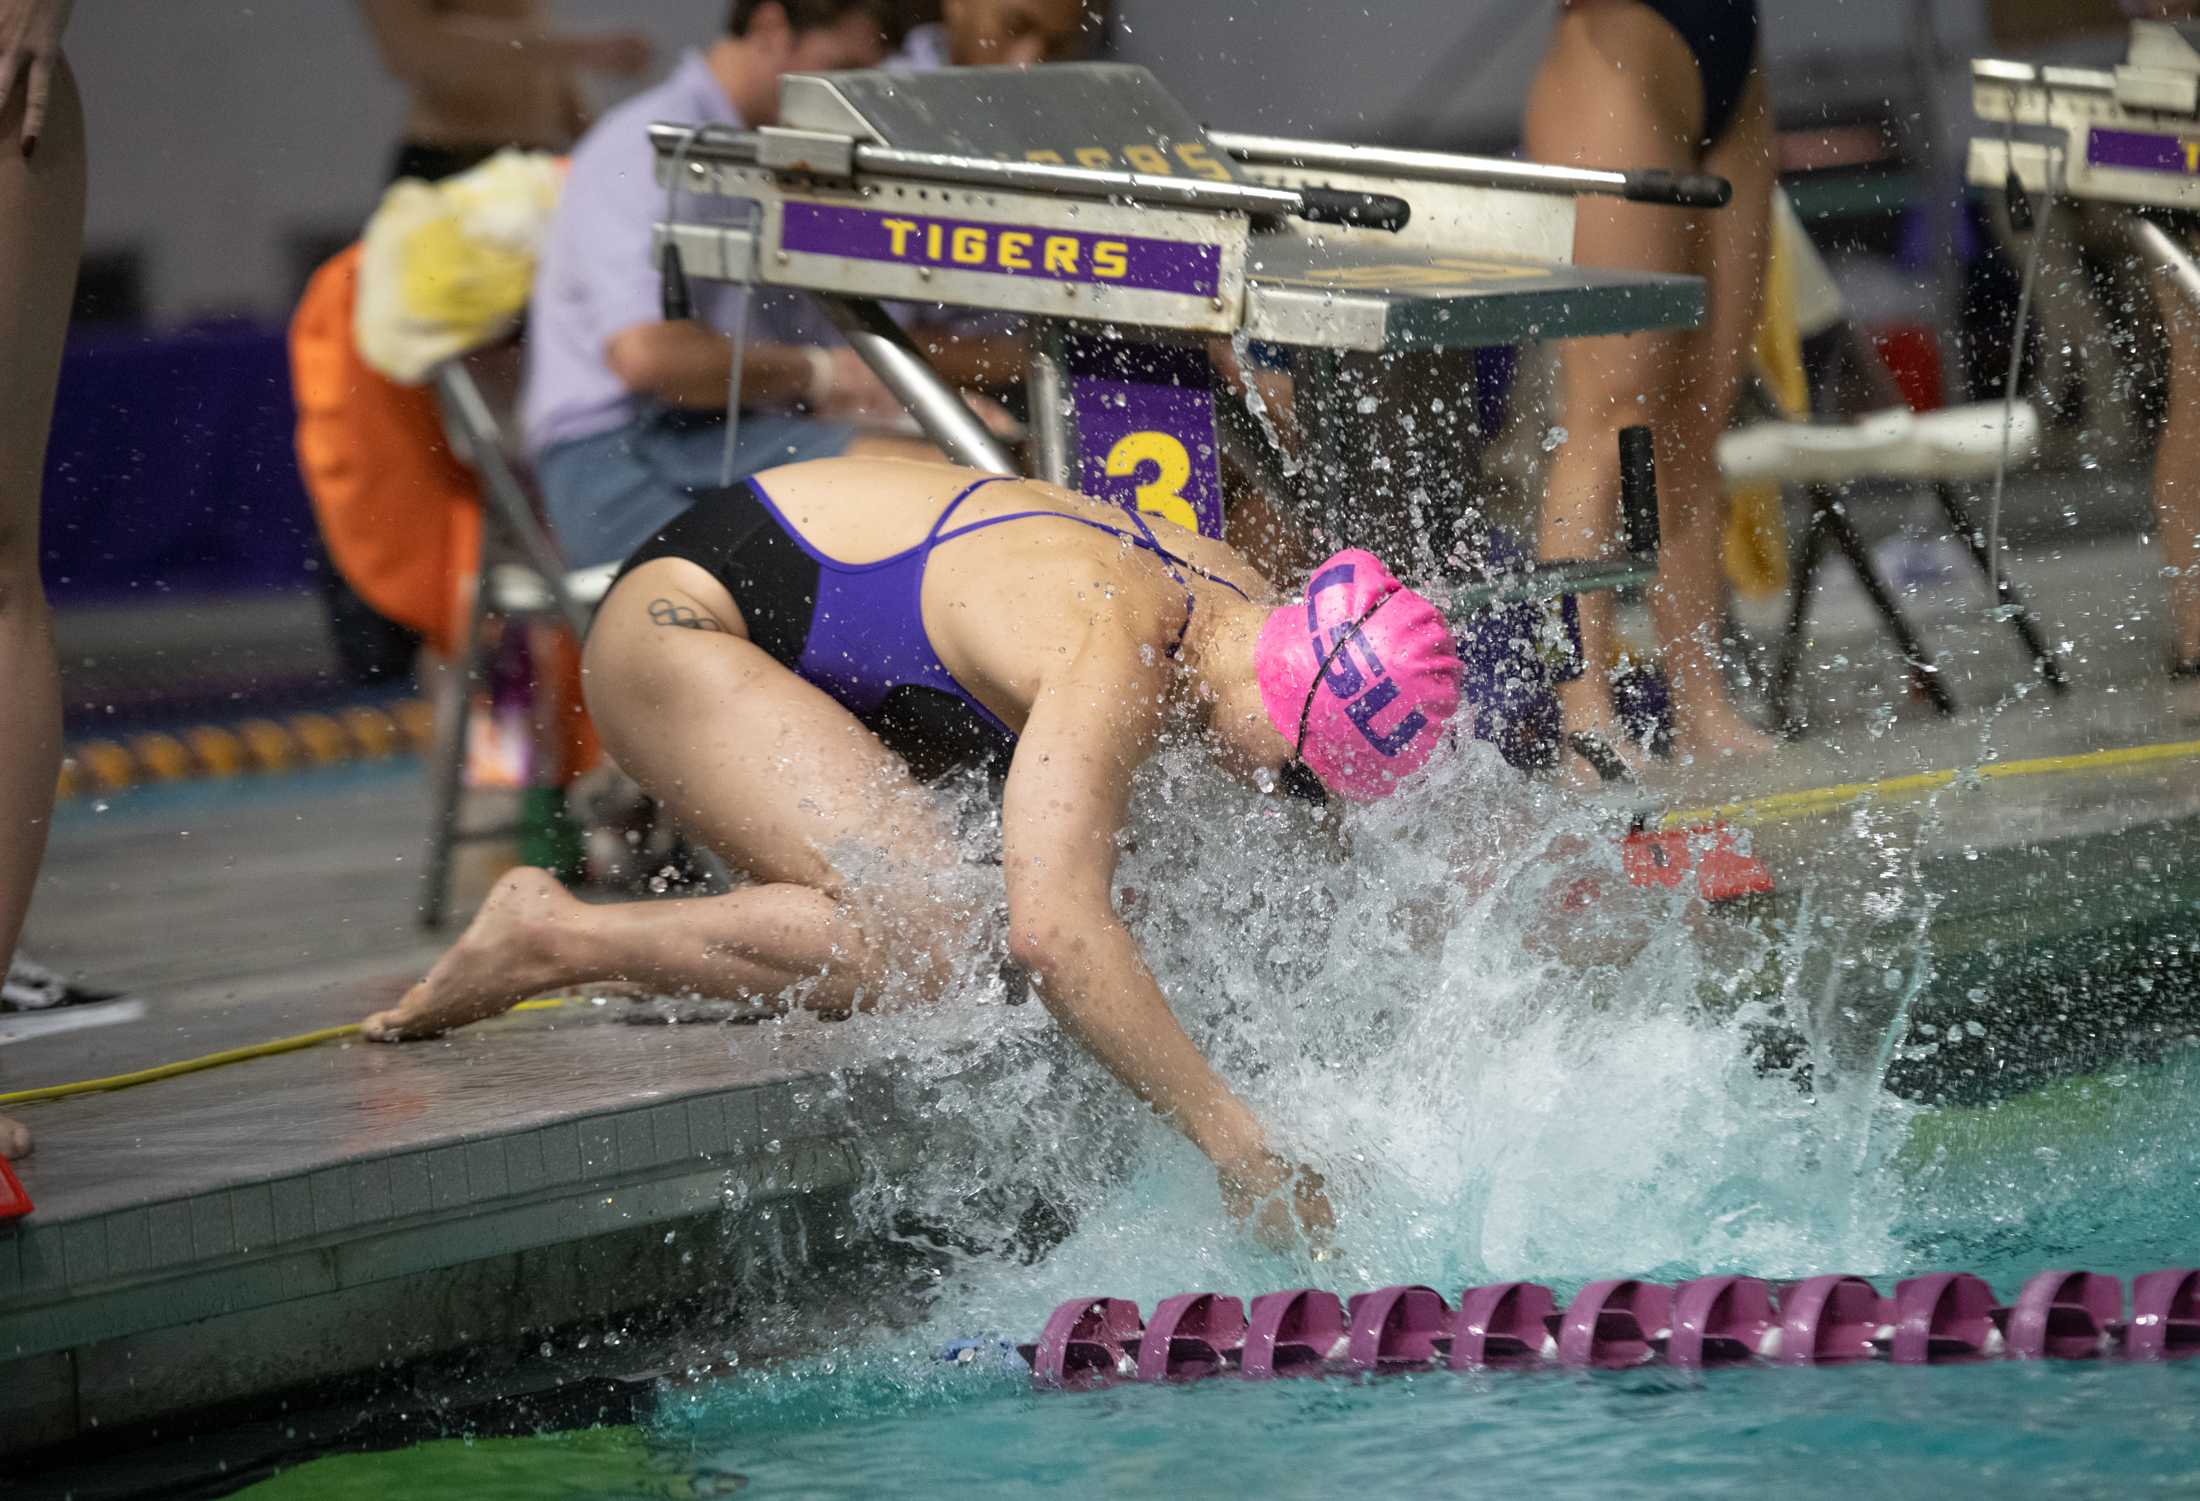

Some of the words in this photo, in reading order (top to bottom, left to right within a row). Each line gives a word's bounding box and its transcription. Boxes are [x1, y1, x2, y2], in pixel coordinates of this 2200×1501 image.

[882, 218, 1129, 278] TIGERS
[1104, 430, 1199, 534] 3
[1307, 563, 1429, 757] LSU
